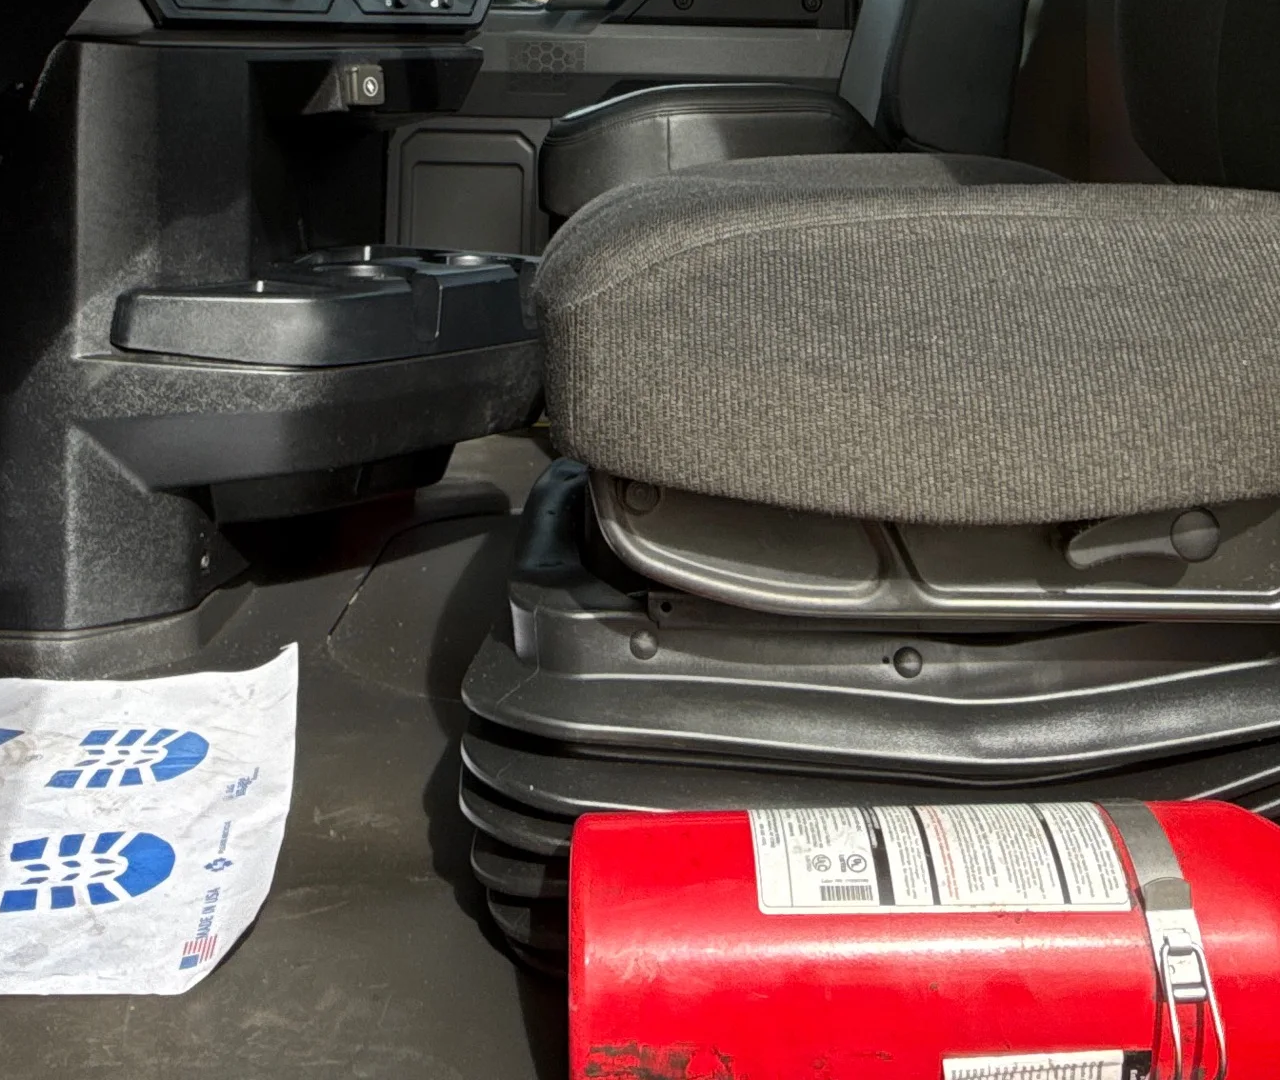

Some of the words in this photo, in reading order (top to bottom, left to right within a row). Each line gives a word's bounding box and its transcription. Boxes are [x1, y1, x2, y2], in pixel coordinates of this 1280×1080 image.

[205, 887, 220, 904] USA
[202, 904, 217, 916] IN
[195, 917, 213, 940] MADE
